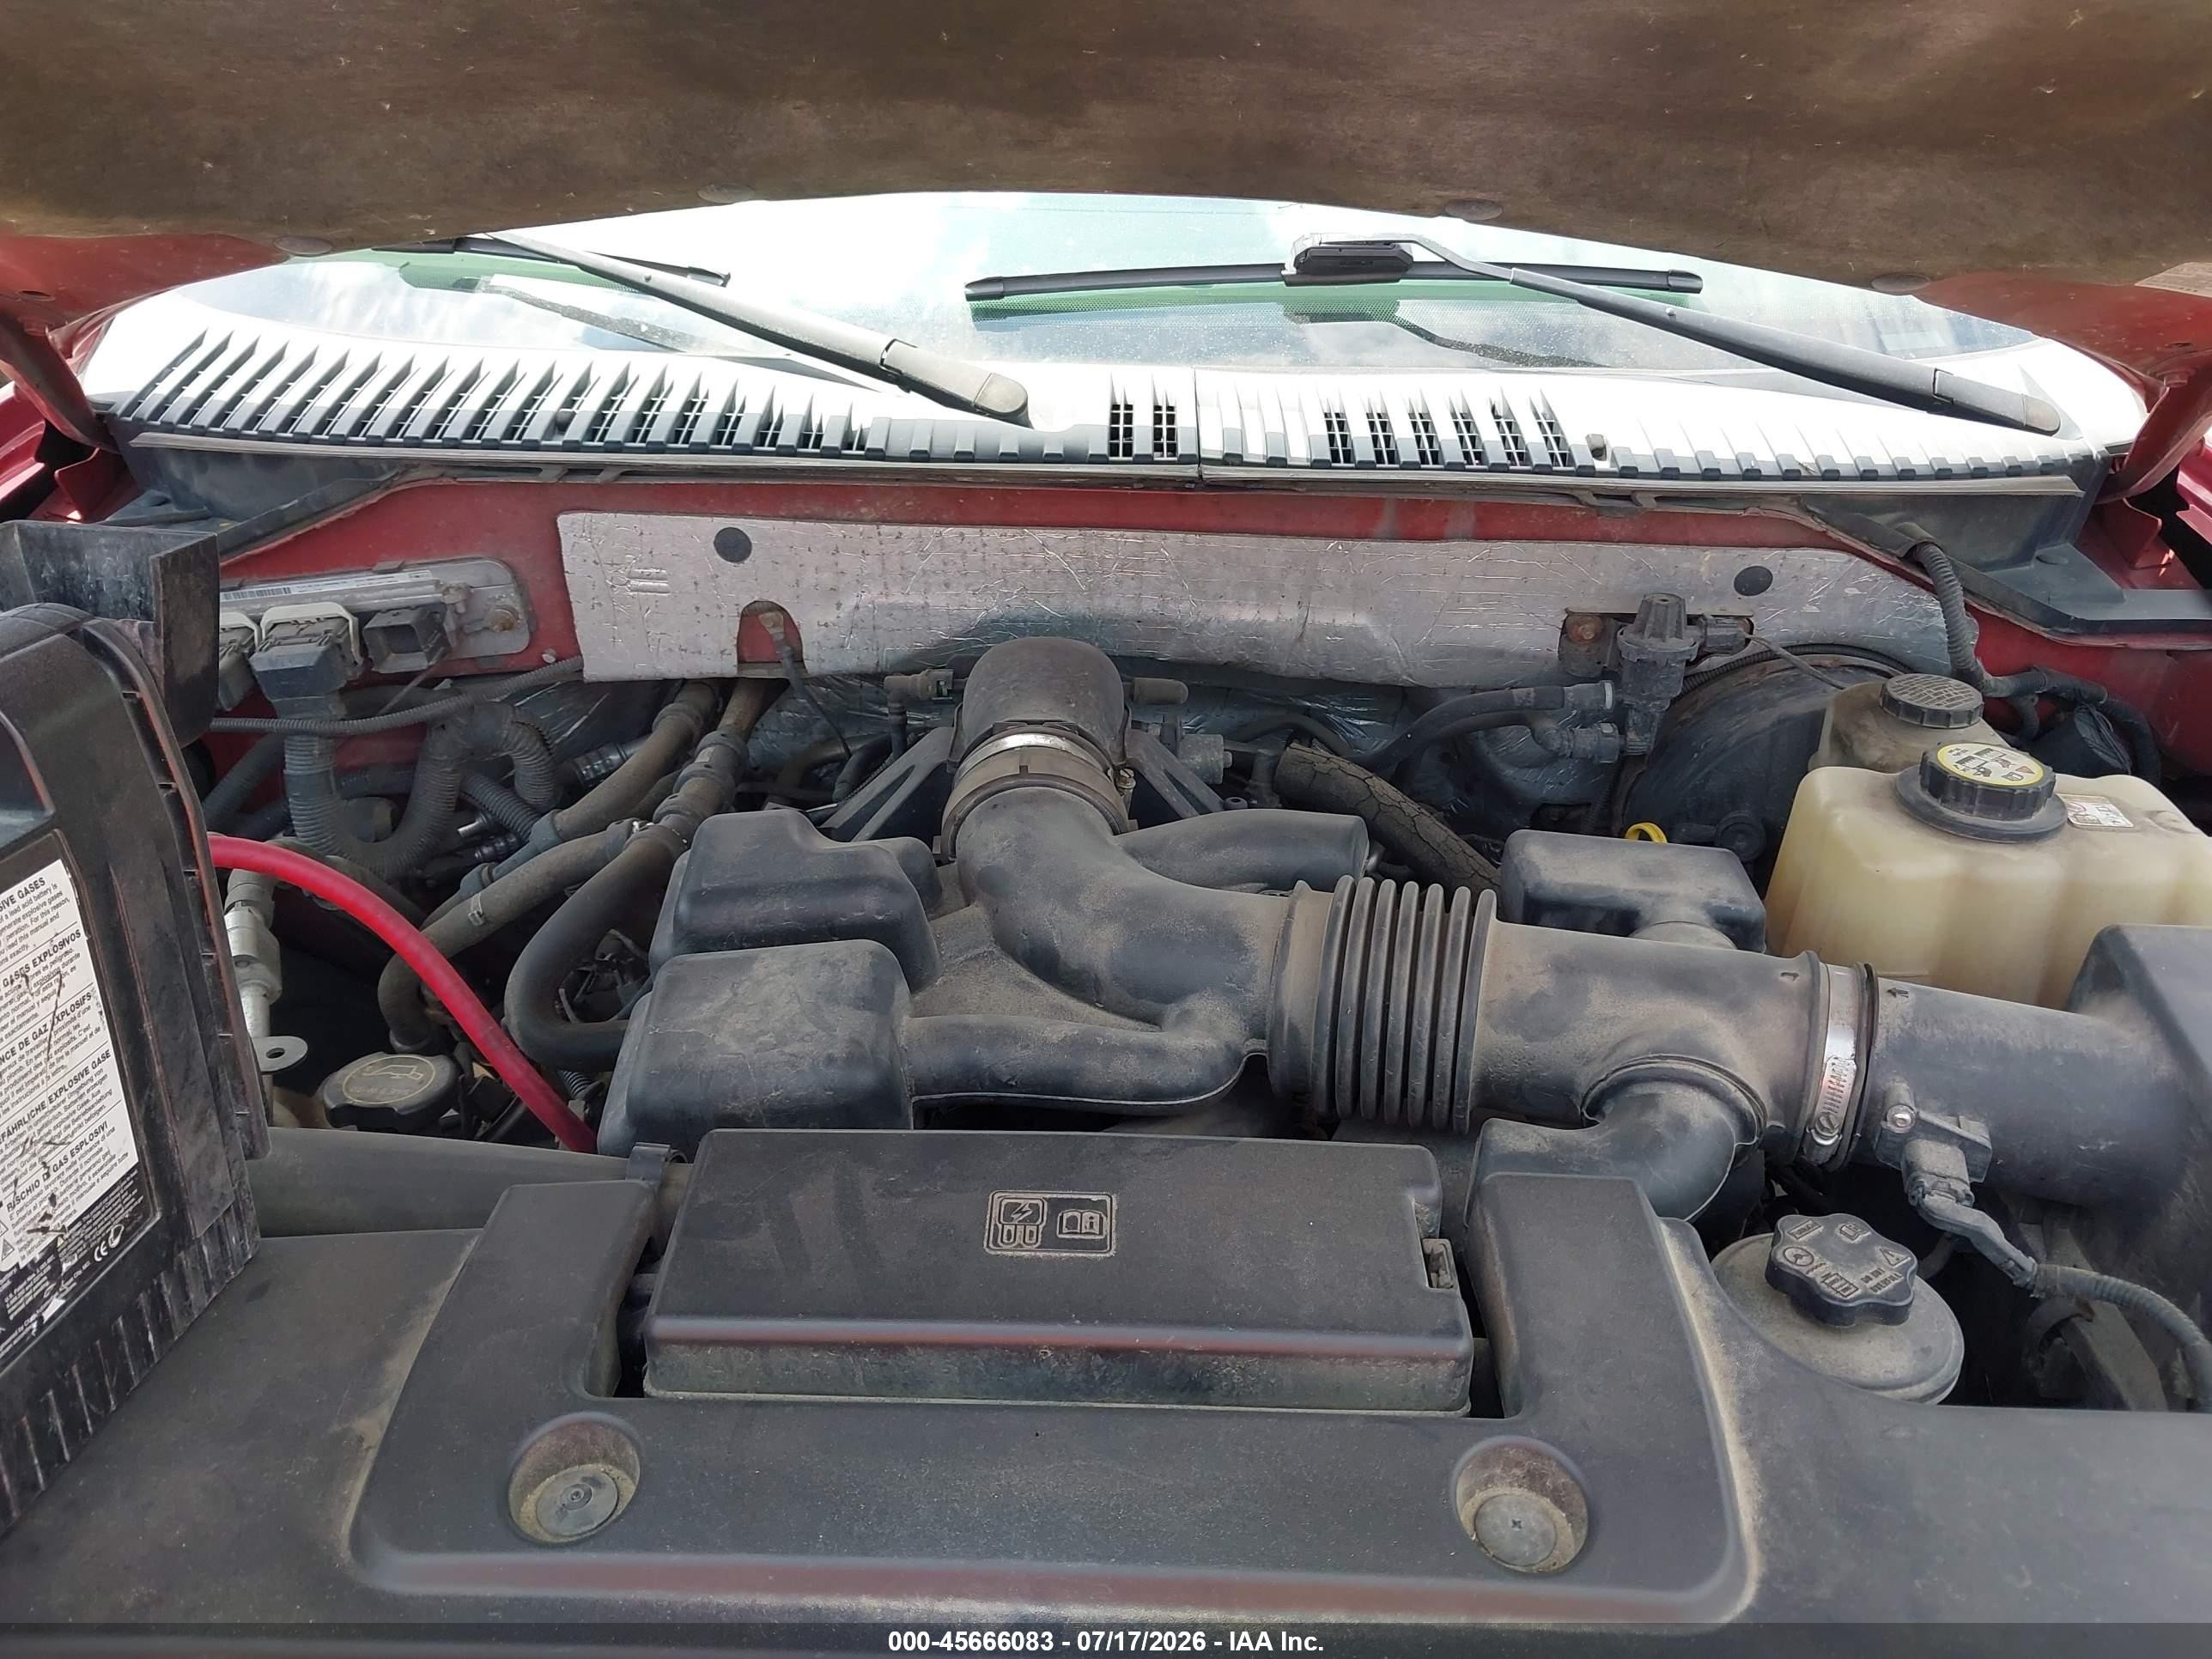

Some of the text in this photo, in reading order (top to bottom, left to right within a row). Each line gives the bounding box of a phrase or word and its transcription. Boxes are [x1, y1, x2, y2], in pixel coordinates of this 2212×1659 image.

[17, 877, 46, 899] GASES
[9, 905, 21, 917] lead
[21, 897, 33, 909] acid
[33, 887, 52, 902] battery
[21, 901, 47, 920] explosive
[47, 890, 63, 905] gases
[6, 923, 30, 943] peration.
[29, 915, 40, 926] For
[40, 908, 51, 919] this
[18, 933, 29, 943] this
[29, 918, 49, 936] manual
[50, 911, 59, 923] and
[32, 929, 81, 968] EXPLOSIVOS
[61, 952, 81, 969] durante
[42, 981, 53, 993] esta
[16, 1003, 36, 1021] manual
[32, 1023, 49, 1041] GAZ
[72, 1023, 81, 1031] les
[33, 1060, 43, 1071] des
[94, 1067, 104, 1078] von
[48, 1066, 89, 1104] EXPLOSIVE
[91, 1049, 111, 1070] GASE
[52, 1155, 69, 1173] GAS
[70, 1121, 107, 1158] ESPLOSIVI
[94, 1241, 108, 1261] CE
